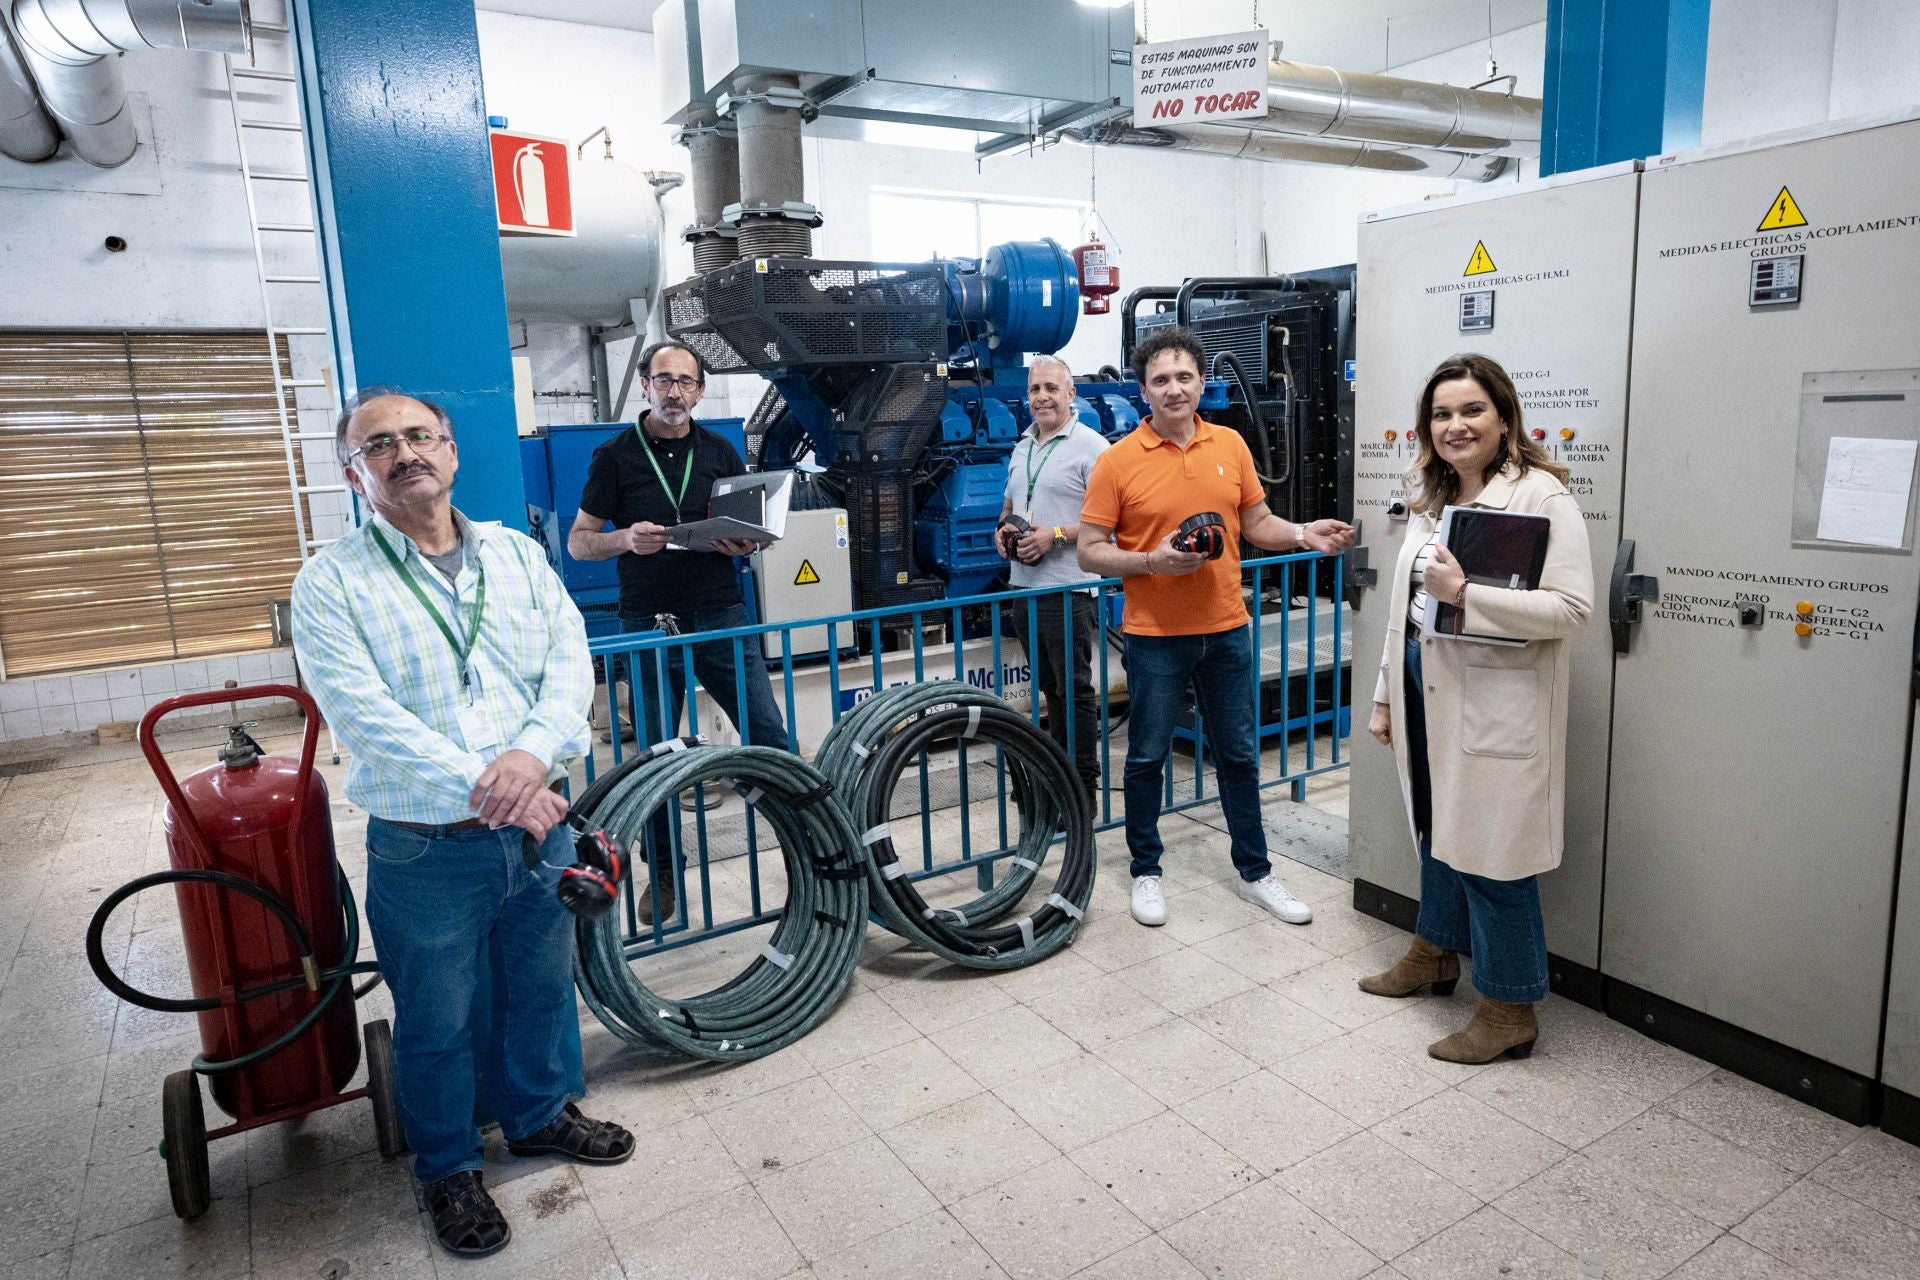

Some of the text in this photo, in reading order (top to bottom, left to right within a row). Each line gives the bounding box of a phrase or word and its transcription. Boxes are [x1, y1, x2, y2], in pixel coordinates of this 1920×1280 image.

[1141, 51, 1175, 64] ESTAS
[1177, 44, 1234, 60] MAQUINAS
[1236, 41, 1259, 54] SON
[1141, 57, 1257, 80] DE FUNCIONAMIENTO
[1141, 78, 1214, 95] AUTOMATICO
[1152, 90, 1260, 119] NO TOCAR
[1659, 215, 1920, 259] MEDIDAS ELECTRICAS ACOPLAMIENT
[1750, 243, 1807, 258] GRUPOS
[1425, 283, 1466, 295] MEDIDAS
[1525, 274, 1540, 282] G-1
[1535, 370, 1551, 379] G-1
[1534, 389, 1566, 398] PASAR
[1568, 388, 1589, 397] POR
[1523, 399, 1600, 409] POSICIÓN TEST
[1563, 444, 1610, 452] MARCHA
[1567, 454, 1605, 462] BOMBA
[1577, 487, 1593, 495] G-1
[1356, 499, 1390, 507] MANUAL
[1666, 566, 1889, 594] MANDO ACOPLAMIENTO GRUPOS
[1663, 592, 1739, 609] SINCRONIZA
[1735, 592, 1770, 603] PARO
[1661, 601, 1692, 612] CION
[1816, 604, 1869, 618] G1 G2
[1653, 610, 1735, 628] AUTOMÁTICA
[1768, 610, 1884, 632] TRANSFERENCIA
[1813, 626, 1830, 637] G2
[968, 663, 1031, 690] Moins
